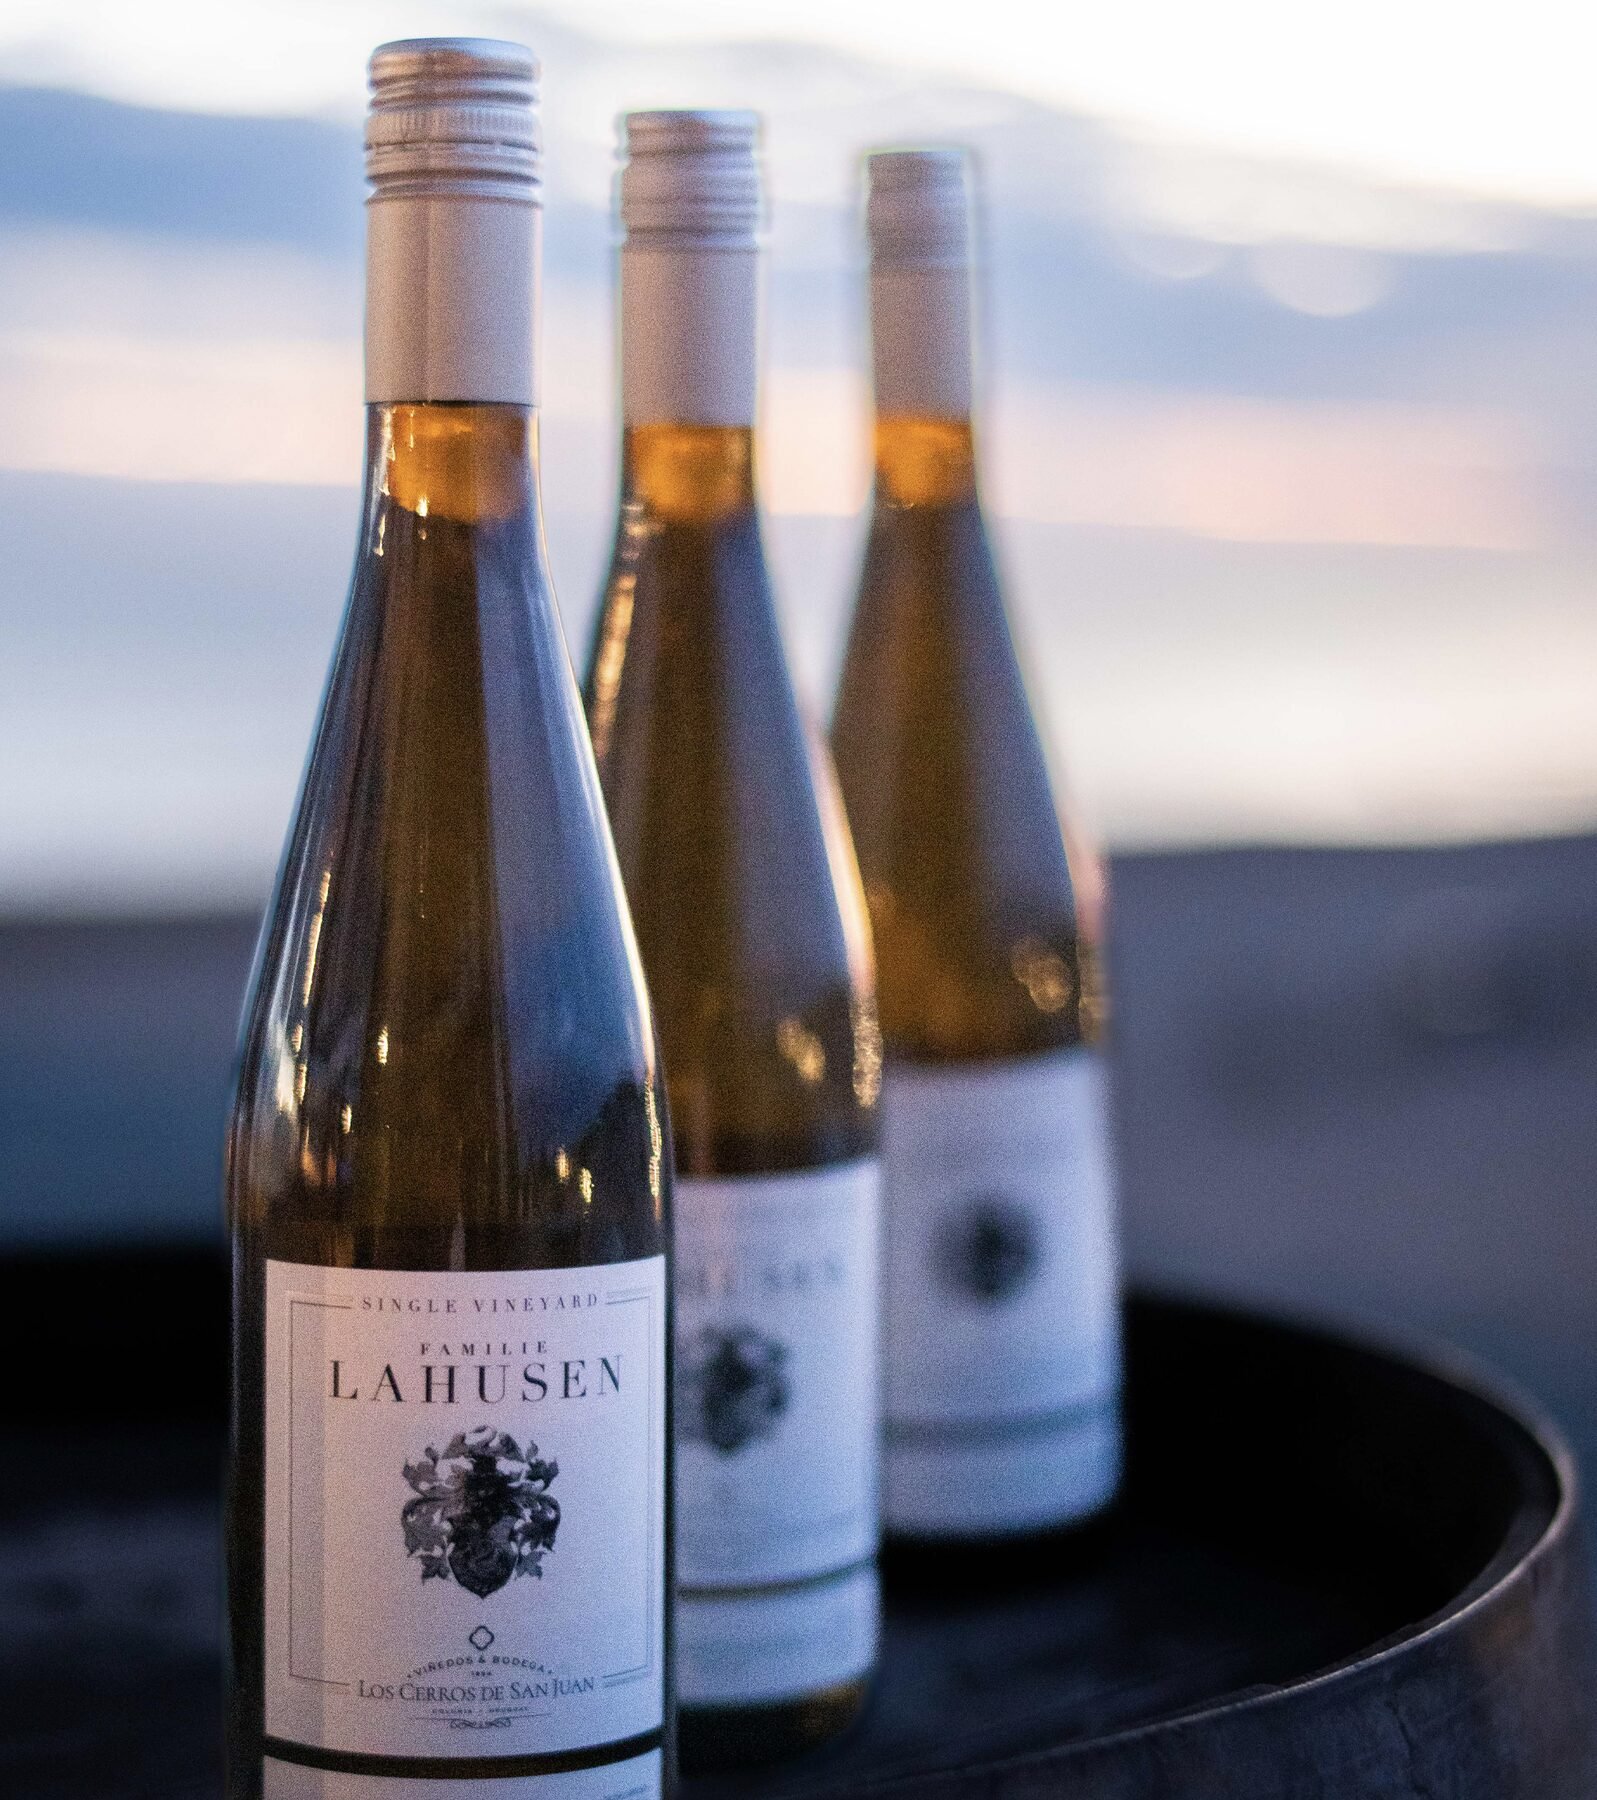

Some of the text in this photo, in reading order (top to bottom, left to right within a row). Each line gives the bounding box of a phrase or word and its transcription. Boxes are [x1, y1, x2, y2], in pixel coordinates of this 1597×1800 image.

[362, 1294, 598, 1313] SINGLE VINEYARD
[419, 1341, 548, 1356] FAMILIE
[329, 1355, 623, 1404] LAHUSEN
[492, 1655, 544, 1673] BODEGA
[481, 1685, 504, 1701] DE
